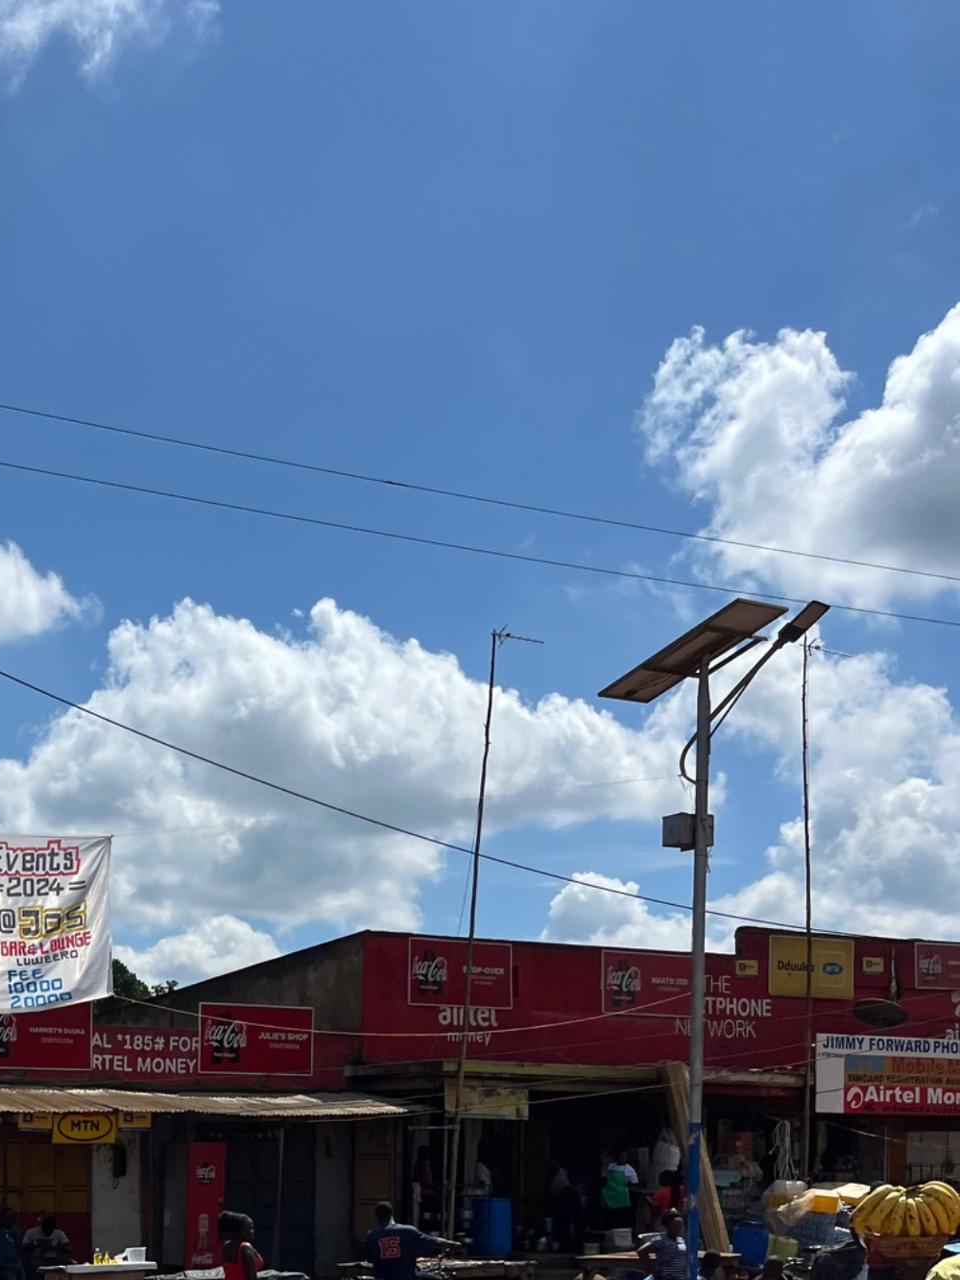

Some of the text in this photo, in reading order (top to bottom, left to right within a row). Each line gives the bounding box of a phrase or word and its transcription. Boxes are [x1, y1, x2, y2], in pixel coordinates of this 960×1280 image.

[7, 877, 64, 897] 2024
[703, 996, 772, 1017] TPHONE
[674, 1017, 758, 1040] NEWORK
[823, 1035, 960, 1054] JIMMY FORWARD PHO
[137, 1057, 197, 1074] MONEY
[864, 1085, 921, 1104] Airtel
[70, 1119, 100, 1131] MTN
